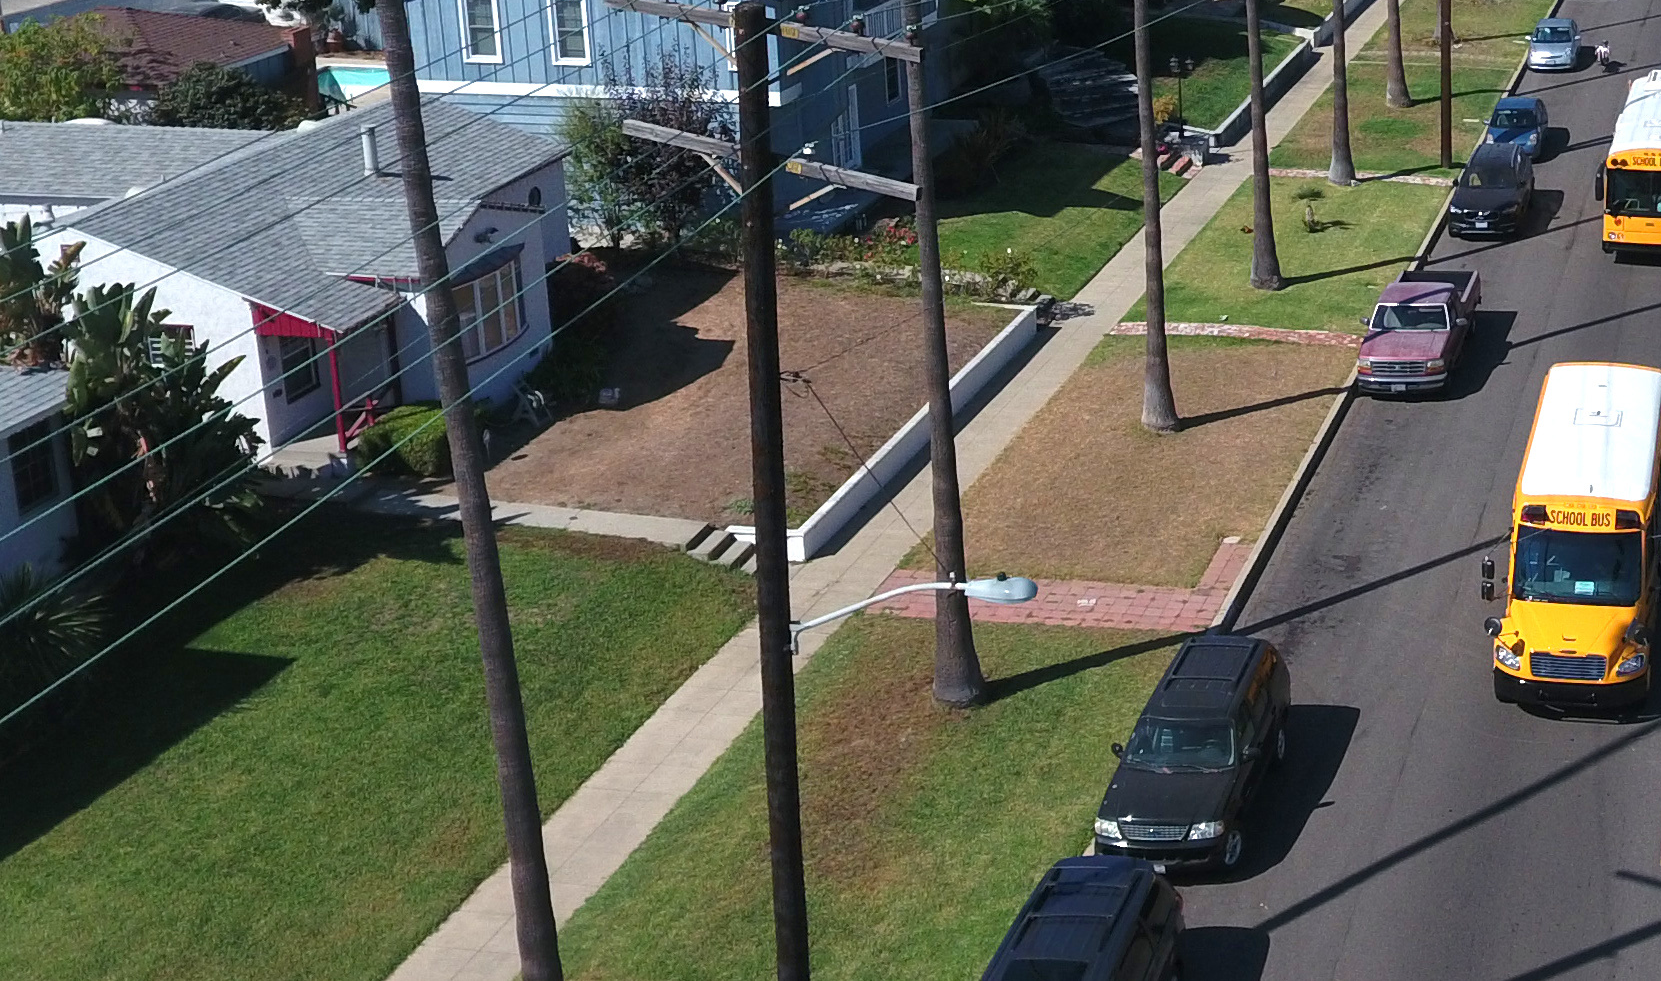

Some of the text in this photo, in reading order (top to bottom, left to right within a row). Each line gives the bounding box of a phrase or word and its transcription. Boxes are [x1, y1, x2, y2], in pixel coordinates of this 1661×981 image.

[1632, 156, 1657, 167] SCHOOL
[1550, 509, 1611, 527] SCHOOL BUS
